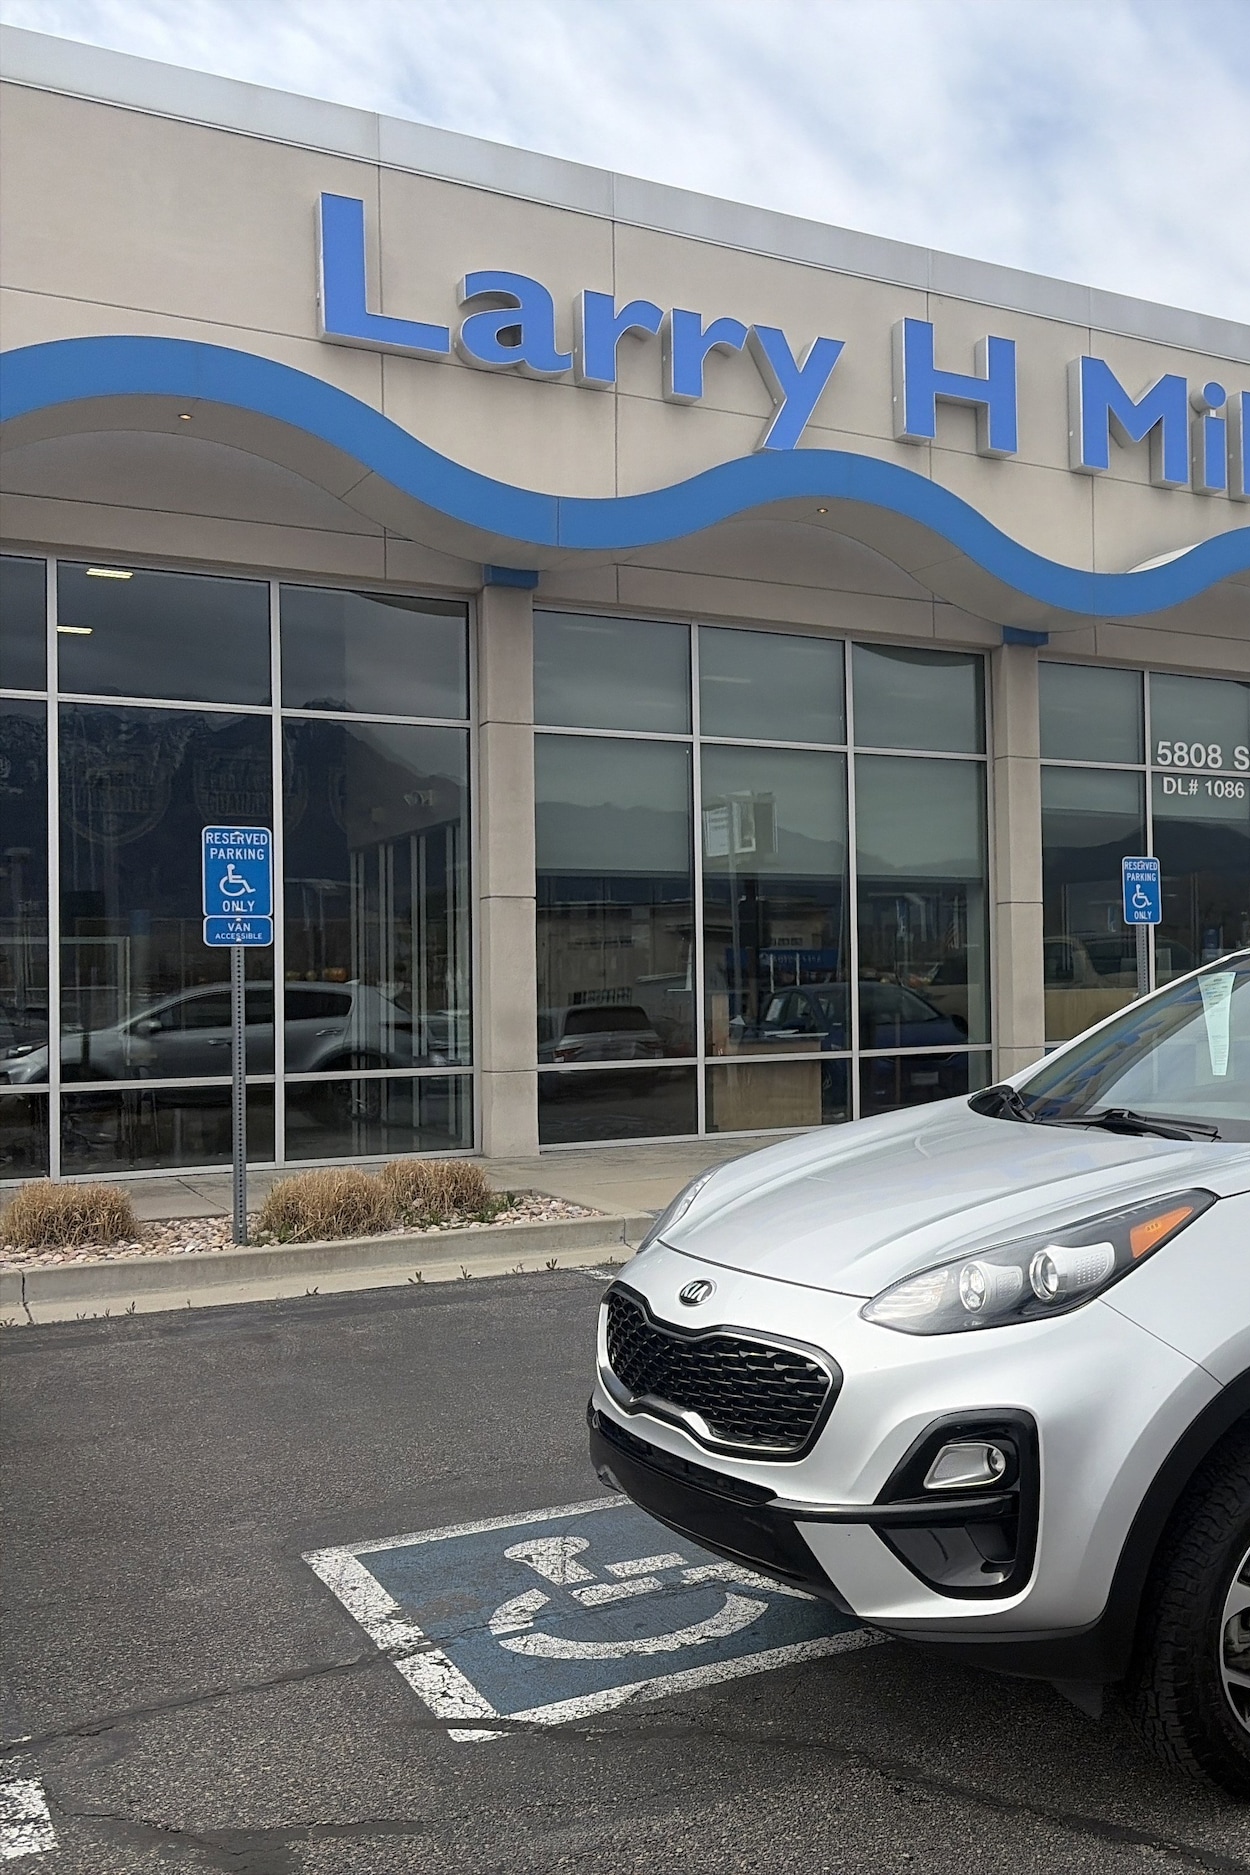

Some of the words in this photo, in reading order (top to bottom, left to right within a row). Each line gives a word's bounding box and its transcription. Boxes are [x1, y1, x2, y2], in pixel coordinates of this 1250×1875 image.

[318, 191, 847, 451] Larry
[898, 317, 1018, 456] H
[1156, 740, 1223, 769] 5808
[1233, 745, 1250, 771] S
[1162, 776, 1199, 796] DL#
[1204, 779, 1246, 799] 1086
[205, 832, 269, 846] RESERVED
[209, 847, 265, 861] PARKING
[1124, 861, 1158, 871] RESERVED
[1126, 872, 1157, 882] PARKING
[222, 900, 256, 913] ONLY
[1133, 910, 1153, 920] ONLY
[227, 922, 251, 932] VAN
[214, 932, 263, 940] ACCESSIBLE
[680, 1281, 709, 1302] KIA
